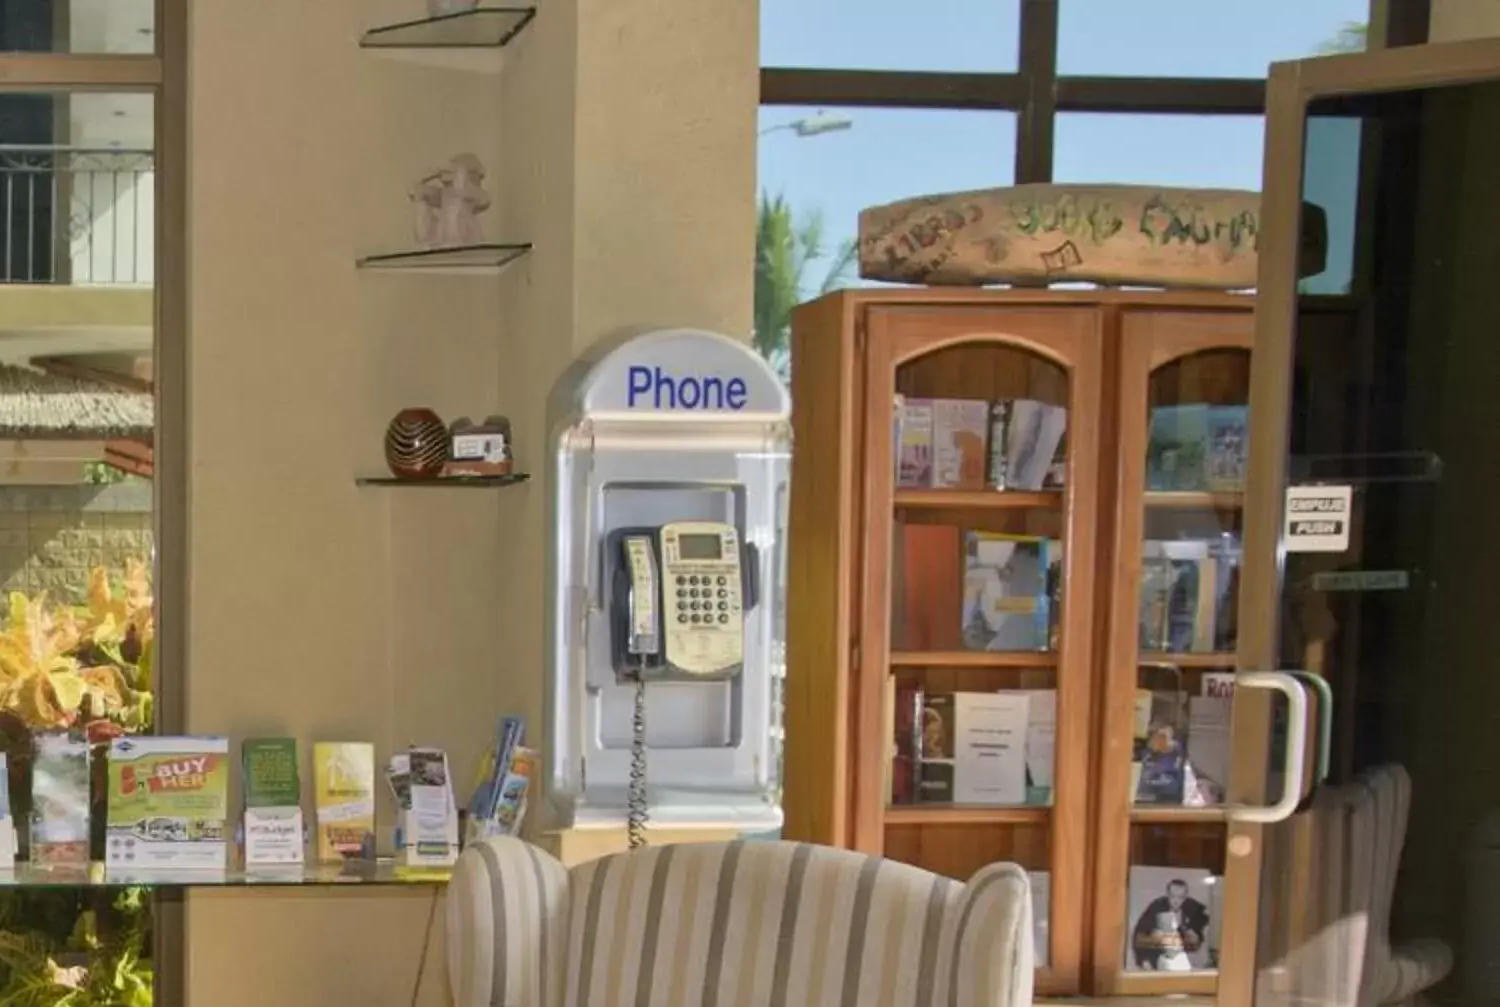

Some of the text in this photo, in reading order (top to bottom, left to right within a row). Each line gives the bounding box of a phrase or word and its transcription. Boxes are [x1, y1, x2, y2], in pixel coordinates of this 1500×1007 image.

[628, 366, 748, 410] Phone
[1296, 521, 1337, 535] PUSH
[156, 757, 207, 777] BUY
